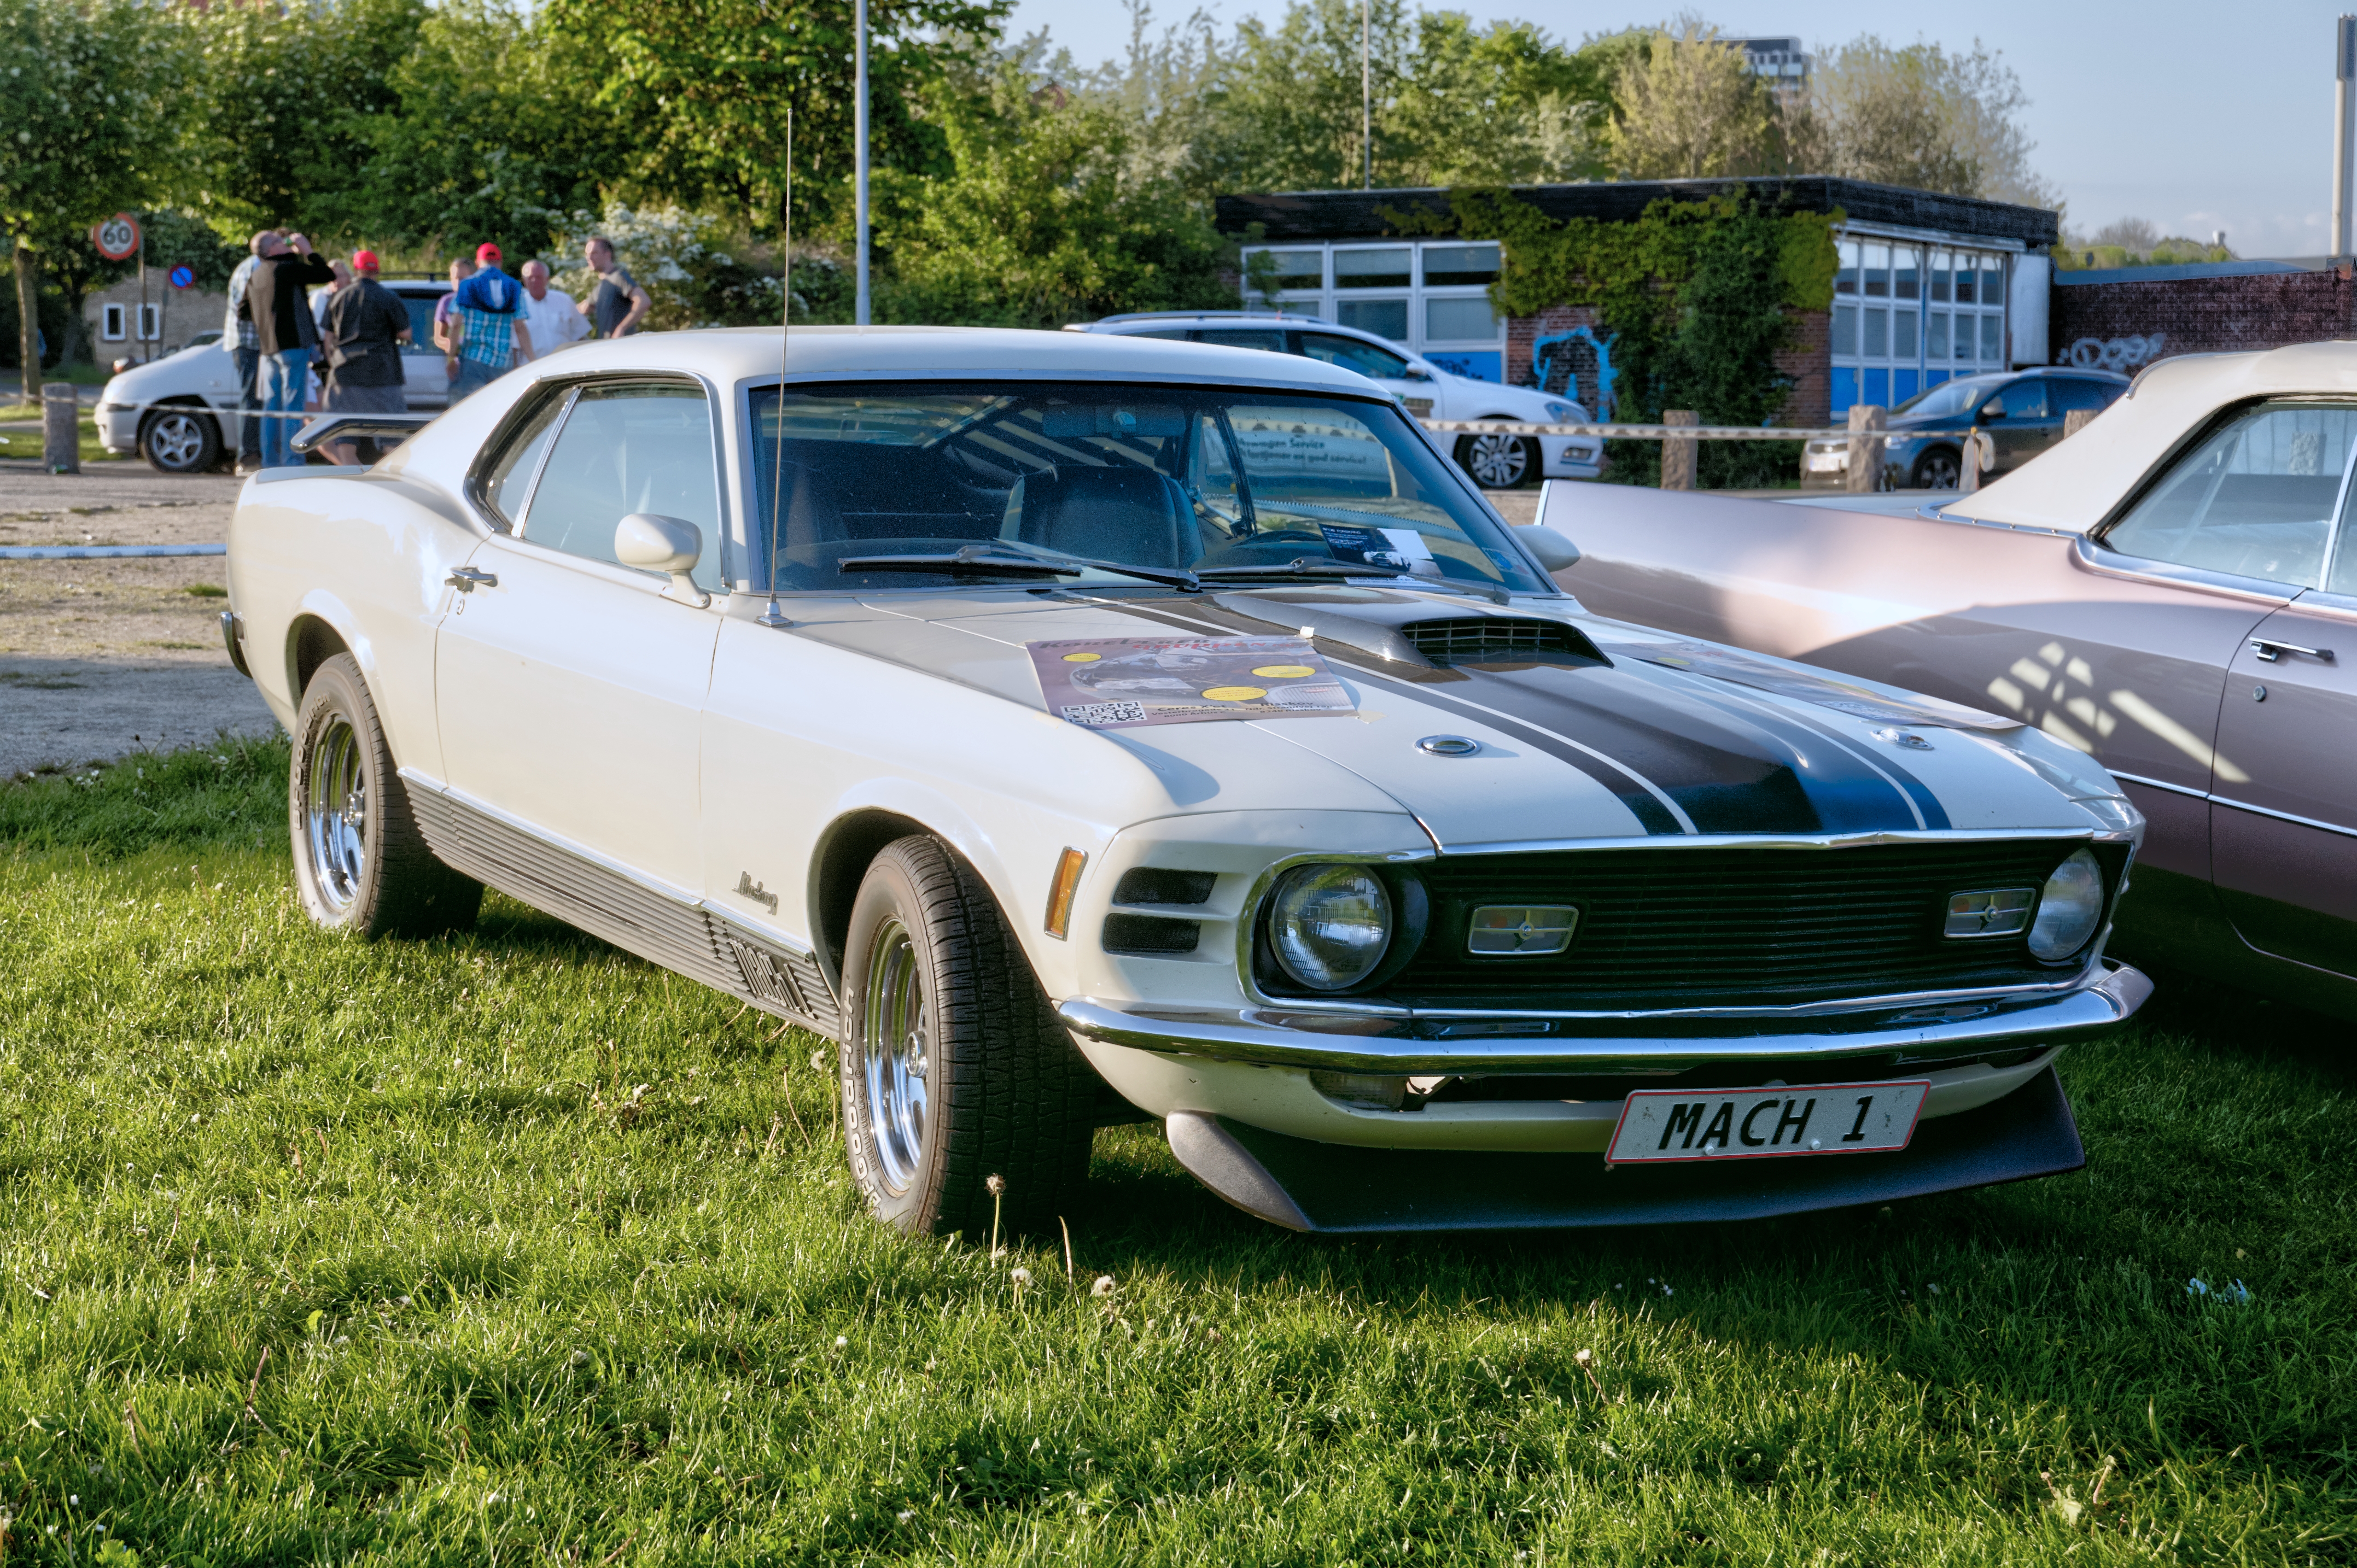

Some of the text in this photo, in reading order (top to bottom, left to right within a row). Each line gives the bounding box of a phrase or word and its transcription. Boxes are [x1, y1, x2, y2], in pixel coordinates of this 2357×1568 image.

[103, 226, 131, 245] 60
[1290, 437, 1325, 449] Service
[1658, 1095, 1874, 1150] MACH 1
